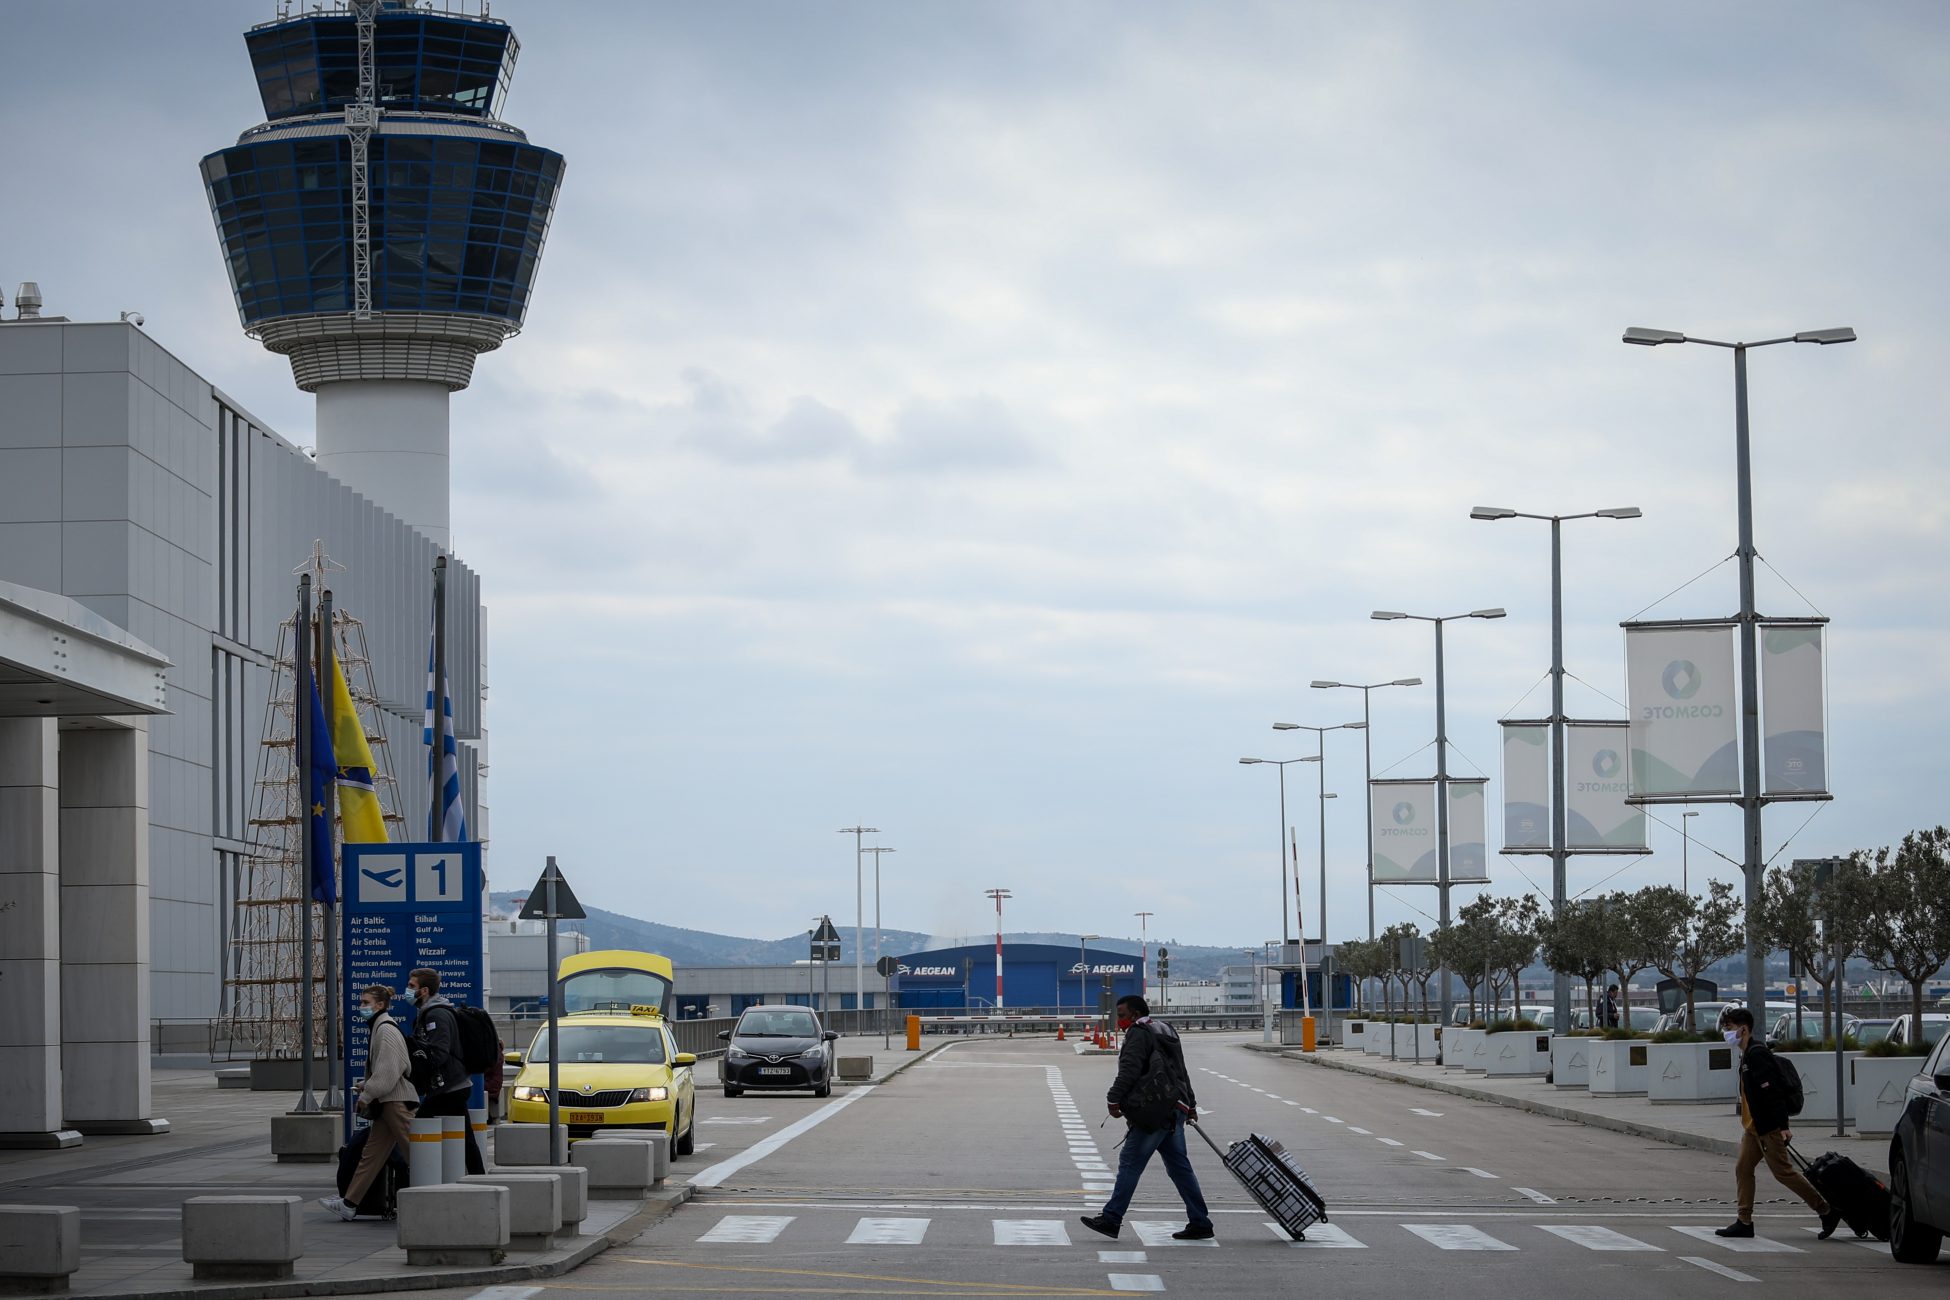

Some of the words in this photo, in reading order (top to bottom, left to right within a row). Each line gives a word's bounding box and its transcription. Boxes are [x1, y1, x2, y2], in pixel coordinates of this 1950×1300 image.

[431, 859, 446, 895] 1
[351, 917, 362, 925] Air
[364, 916, 386, 925] Baltic
[415, 914, 438, 923] Etihad
[351, 938, 362, 946] Air
[363, 938, 387, 946] Serbia
[418, 947, 447, 956] Wizzair
[416, 959, 443, 967] Pegasus
[914, 966, 956, 976] AEGEAN
[1092, 964, 1134, 974] AEGEAN
[371, 970, 397, 978] Airlines
[632, 1005, 656, 1013] TAXI
[352, 1048, 368, 1056] Ellin
